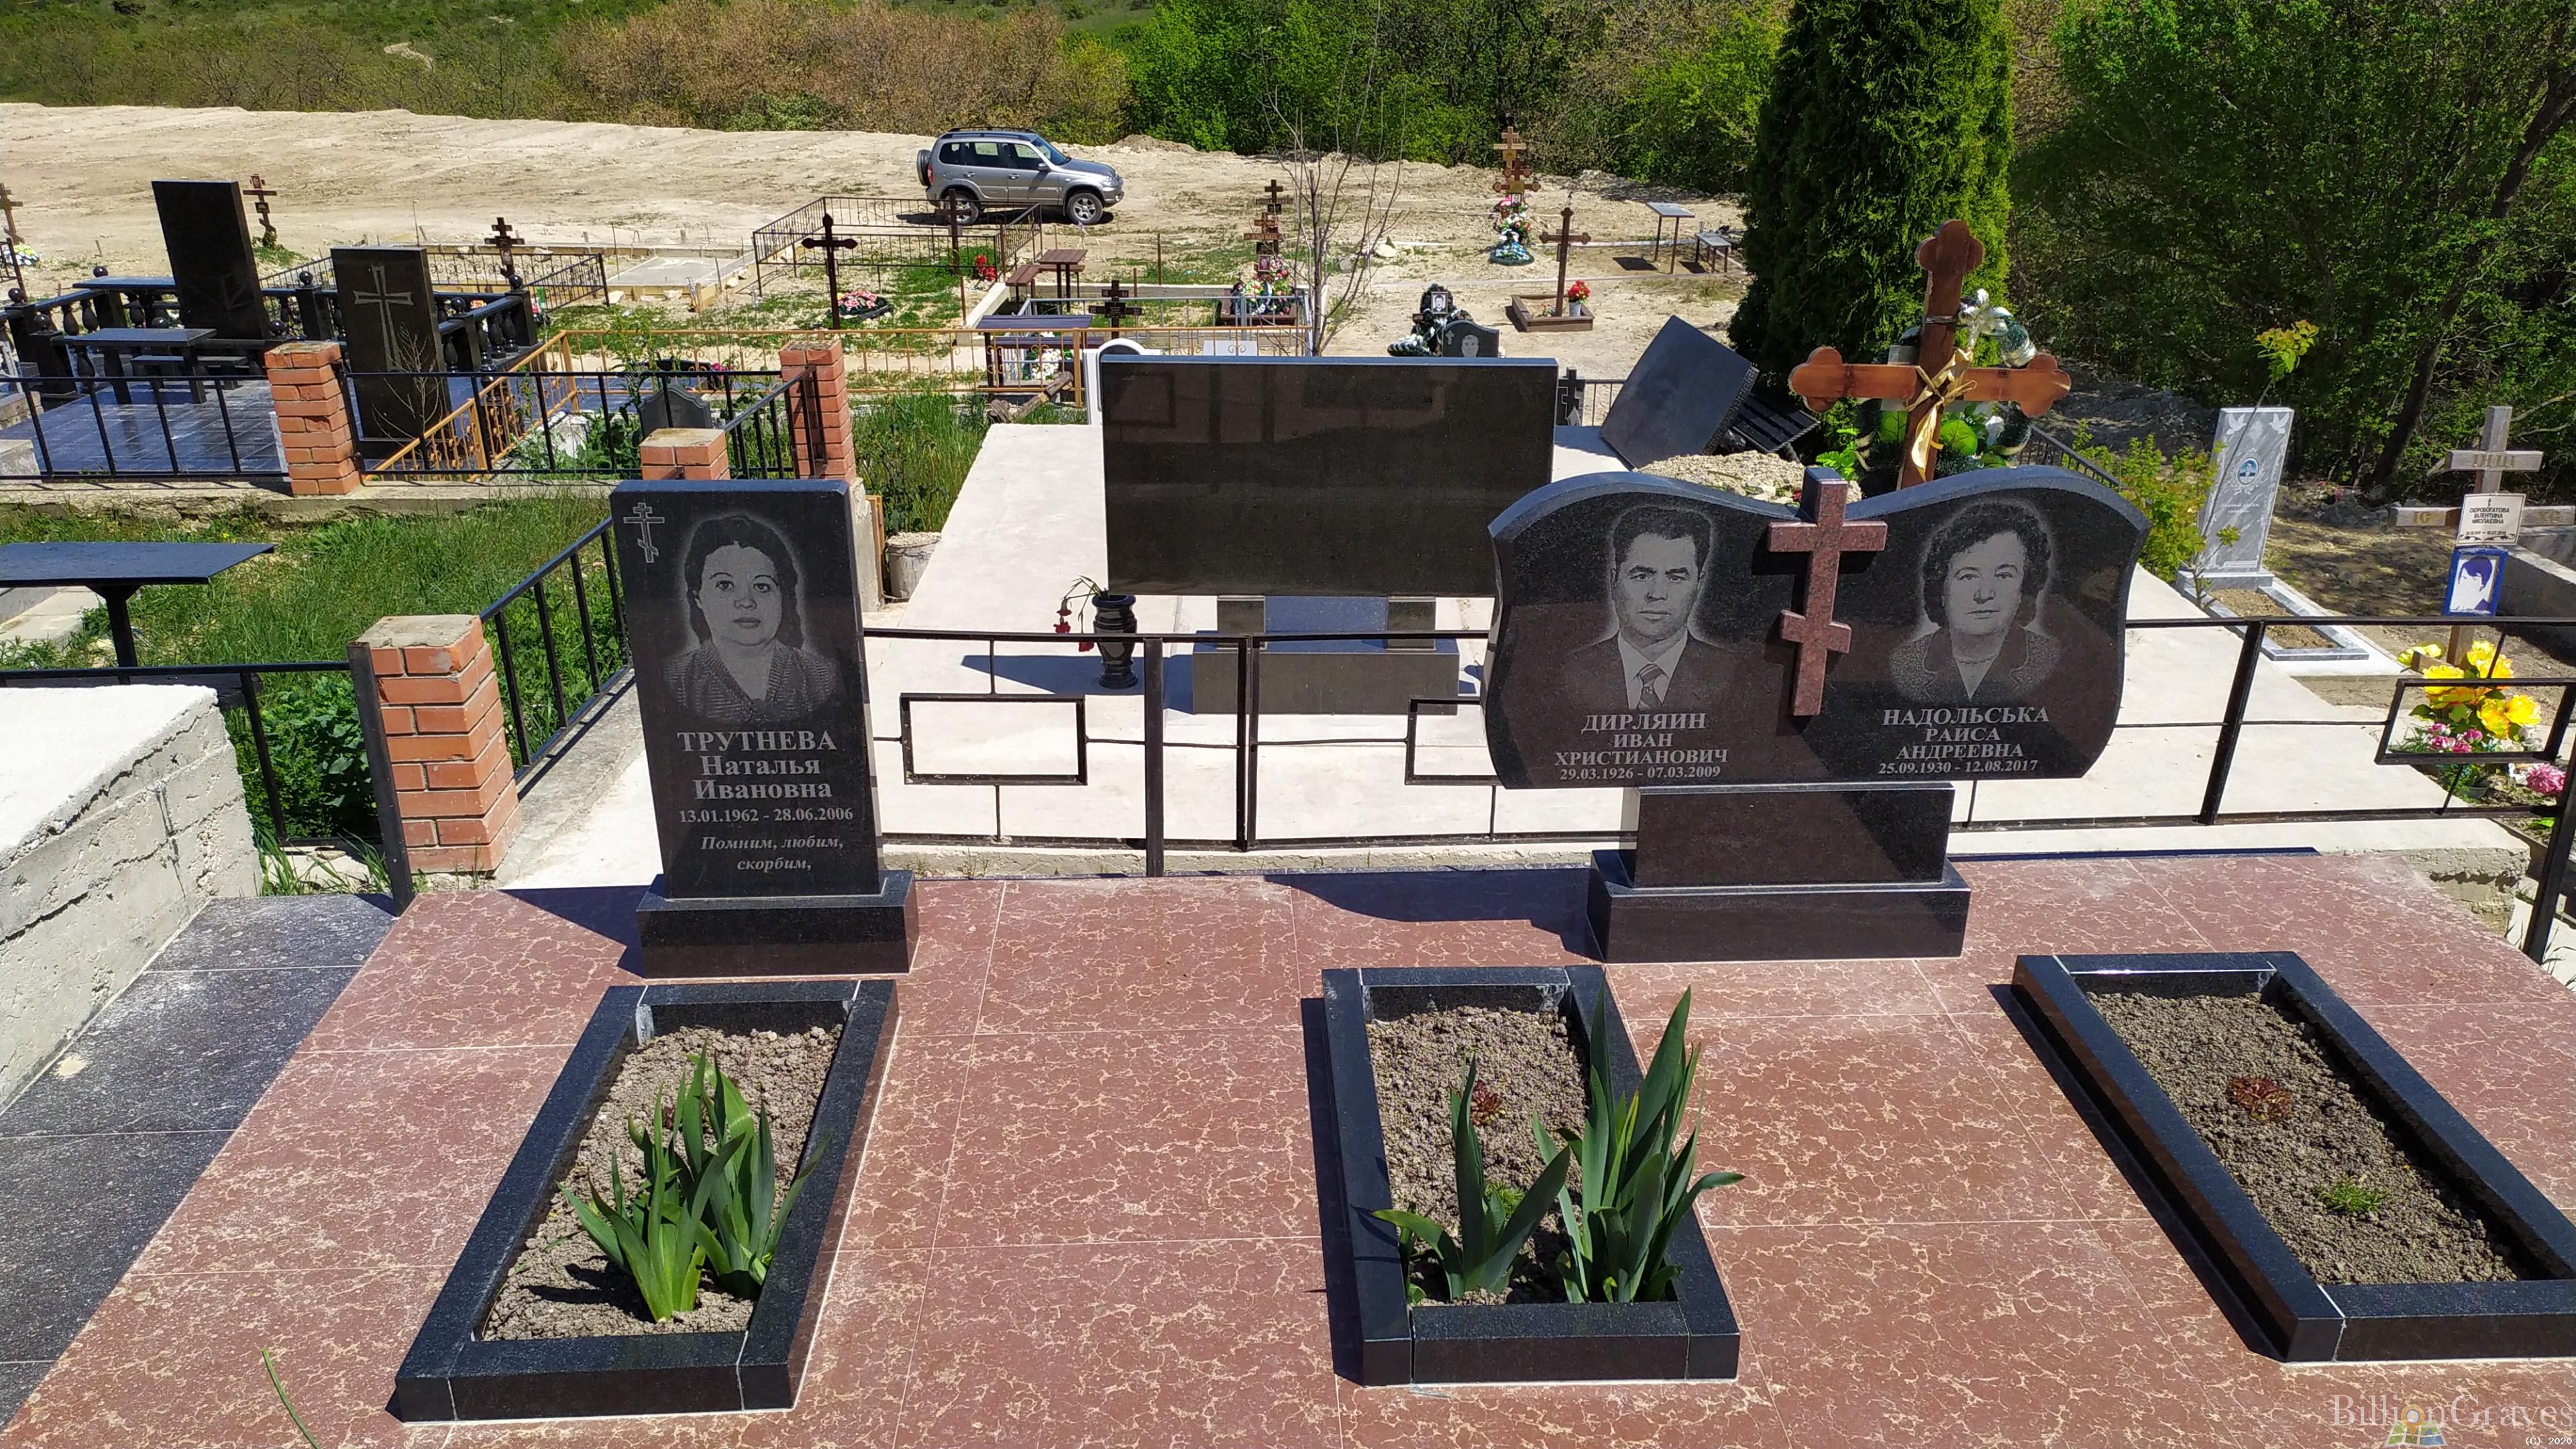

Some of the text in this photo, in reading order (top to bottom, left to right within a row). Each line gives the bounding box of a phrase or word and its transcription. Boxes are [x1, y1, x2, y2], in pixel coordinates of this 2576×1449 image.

[1580, 712, 1707, 735] ДИРЛЯИН
[1882, 706, 2050, 729] НАДОЛЬСЬКА
[677, 730, 838, 753] ТРУТНЕВА
[1613, 733, 1673, 748] ИВАН
[1924, 727, 2001, 742] РАИСА
[1554, 749, 1729, 766] ХРИСТИАНОВИЧ
[1895, 743, 2025, 761] АНДРЕЕВНА
[698, 755, 822, 775] Наталья
[1560, 767, 1634, 780] 29.03.1926
[1647, 766, 1721, 778] 07.03.2009
[1878, 762, 1951, 774] 25.09.1930
[1964, 759, 2039, 772] 12.08.2017
[692, 779, 833, 800] Ивановна
[679, 808, 759, 824] 13.01.1962
[773, 807, 854, 822] 28.06.2006
[700, 835, 845, 851] Помним, любим,
[737, 857, 812, 873] скорбим,
